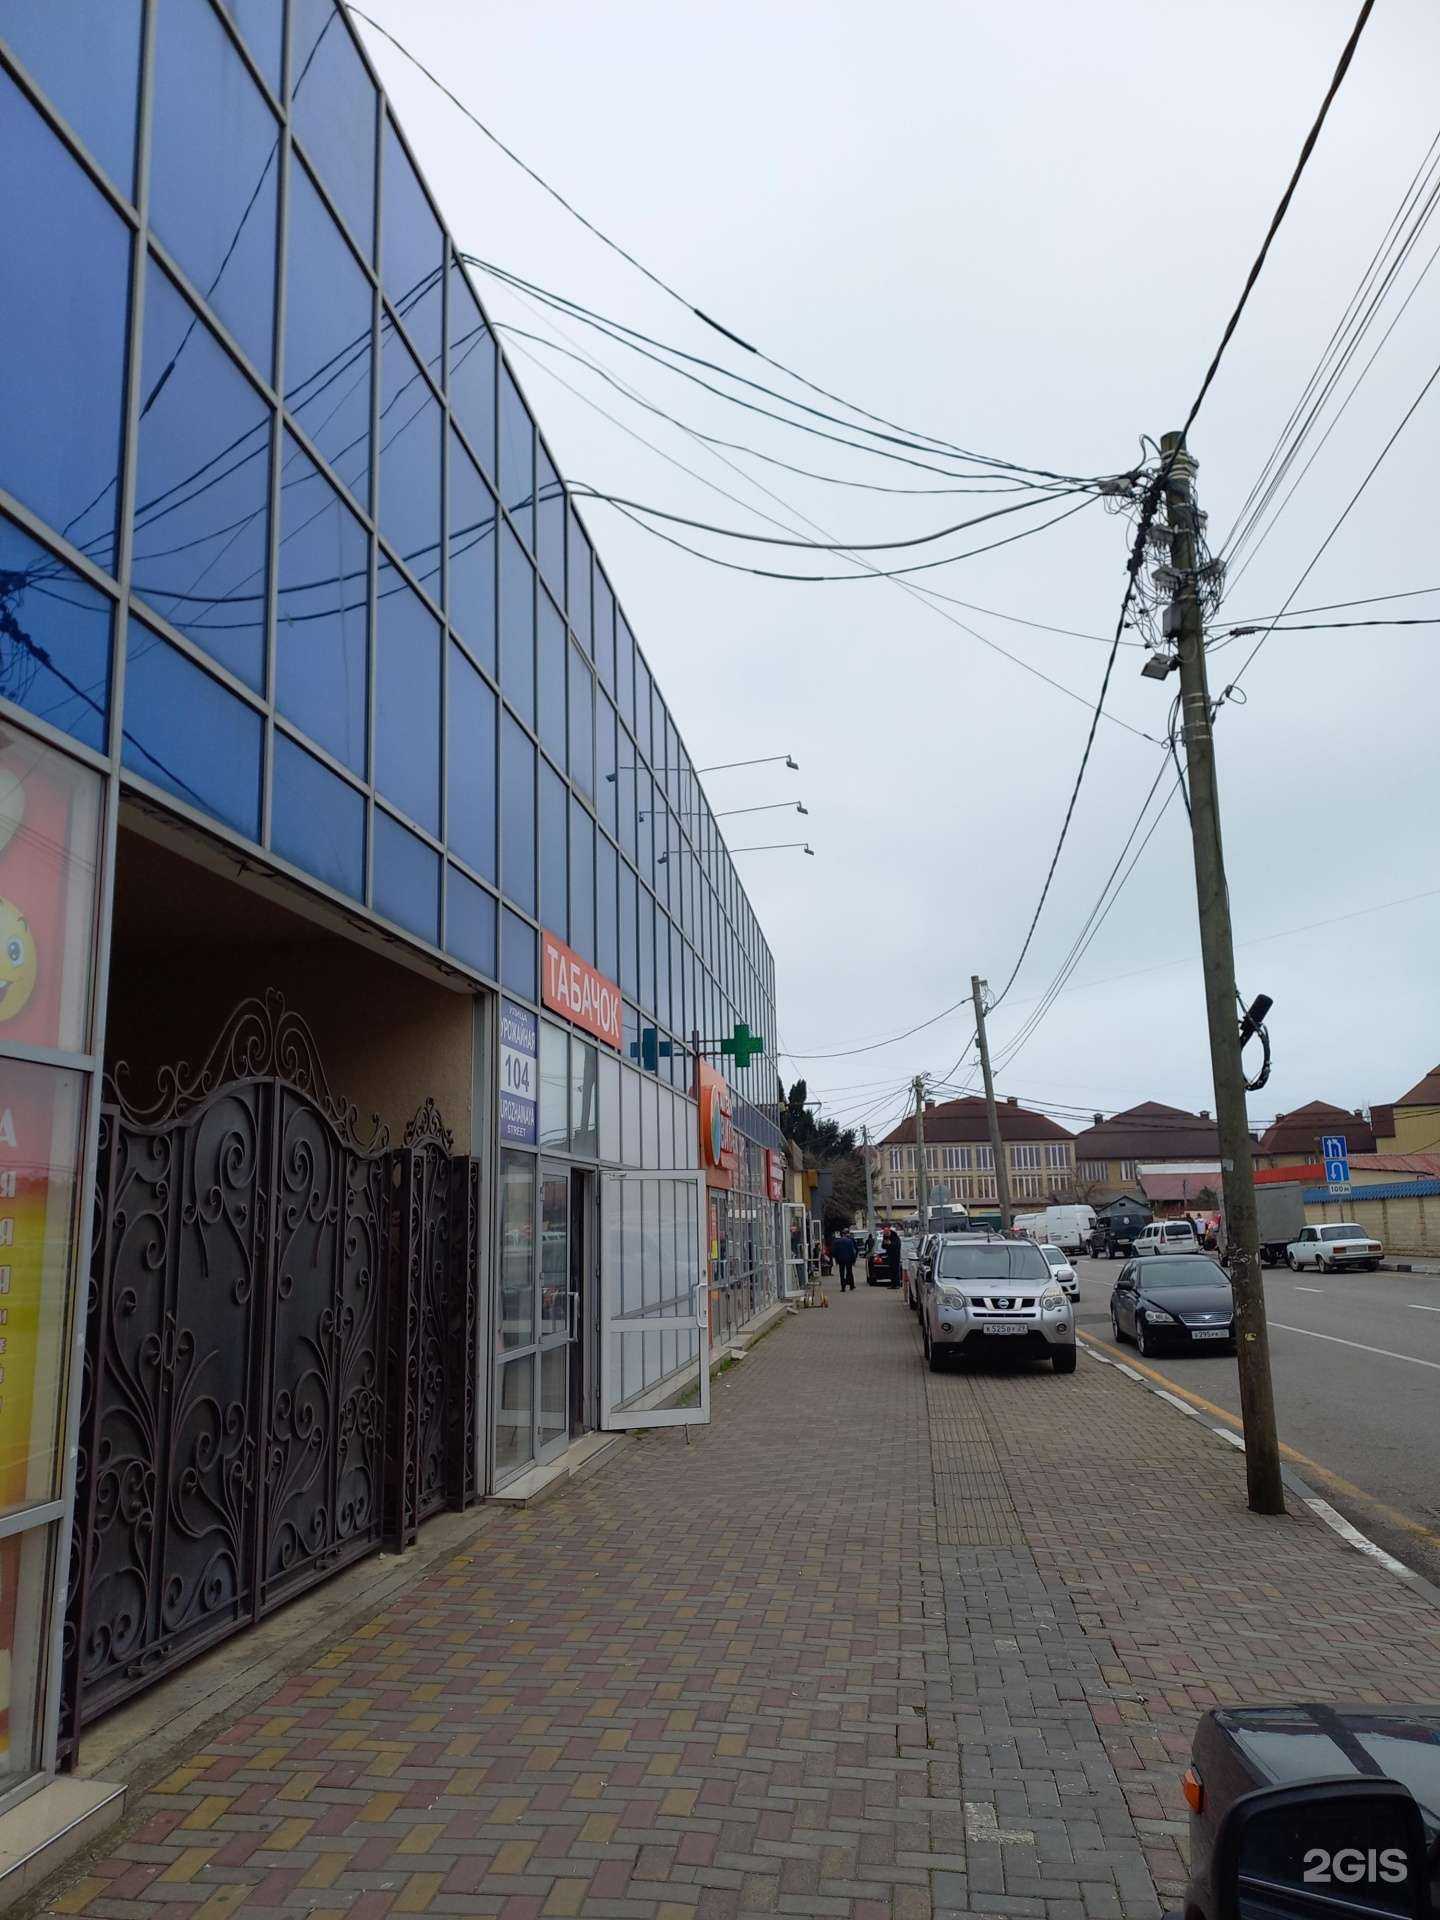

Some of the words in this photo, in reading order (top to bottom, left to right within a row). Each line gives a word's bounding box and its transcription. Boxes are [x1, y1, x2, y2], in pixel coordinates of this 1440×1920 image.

[547, 945, 619, 1039] ТАБАЧОК
[505, 1054, 529, 1092] 104
[507, 1124, 527, 1137] STREET
